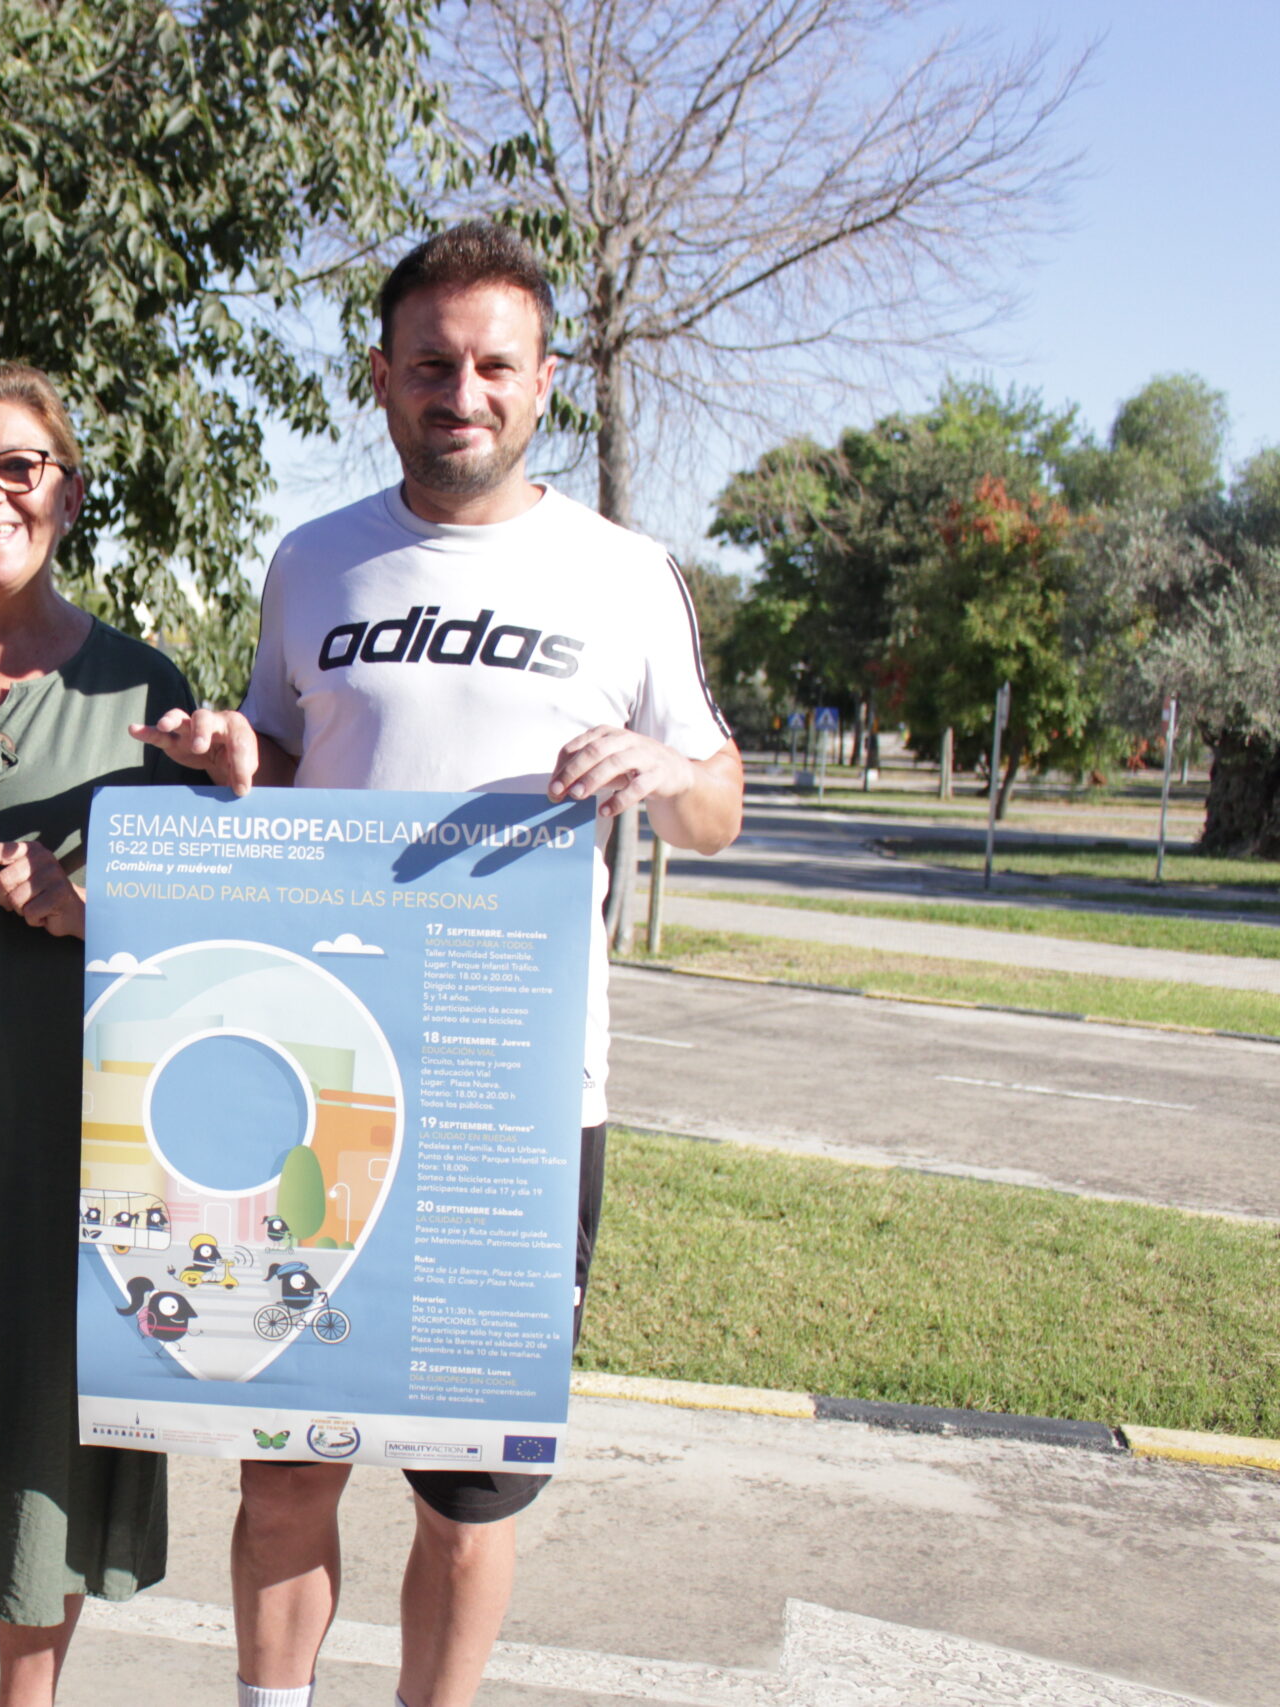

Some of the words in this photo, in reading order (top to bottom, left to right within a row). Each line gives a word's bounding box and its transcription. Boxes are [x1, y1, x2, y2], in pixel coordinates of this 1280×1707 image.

[319, 606, 585, 679] adidas
[109, 814, 575, 849] SEMANAEUROPEADELAMOVILIDAD
[108, 841, 147, 855] 16-22
[152, 842, 175, 856] DE
[179, 843, 284, 859] SEPTIEMBRE
[288, 846, 324, 860] 2025
[106, 860, 162, 872] ¡Combina
[166, 865, 173, 874] y
[177, 863, 232, 874] muévete!
[107, 882, 214, 901] MOVILIDAD
[221, 886, 270, 902] PARA
[277, 888, 344, 905] TODAS
[352, 890, 386, 906] LAS
[393, 891, 498, 910] PERSONAS
[426, 924, 443, 935] 17
[447, 927, 504, 938] SEPTIEMBRE.
[507, 929, 547, 939] miércoles
[423, 1032, 439, 1043] 18
[442, 1035, 499, 1046] SEPTIEMBRE.
[502, 1039, 531, 1047] Jueves
[420, 1117, 437, 1128] 19
[439, 1121, 495, 1131] SEPTIEMBRE.
[417, 1200, 434, 1212] 20
[436, 1205, 490, 1215] SEPTIEMBRE
[492, 1207, 523, 1216] Sábado
[410, 1361, 427, 1372] 22
[429, 1365, 485, 1375] SEPTIEMBRE.
[488, 1368, 511, 1376] Lunes
